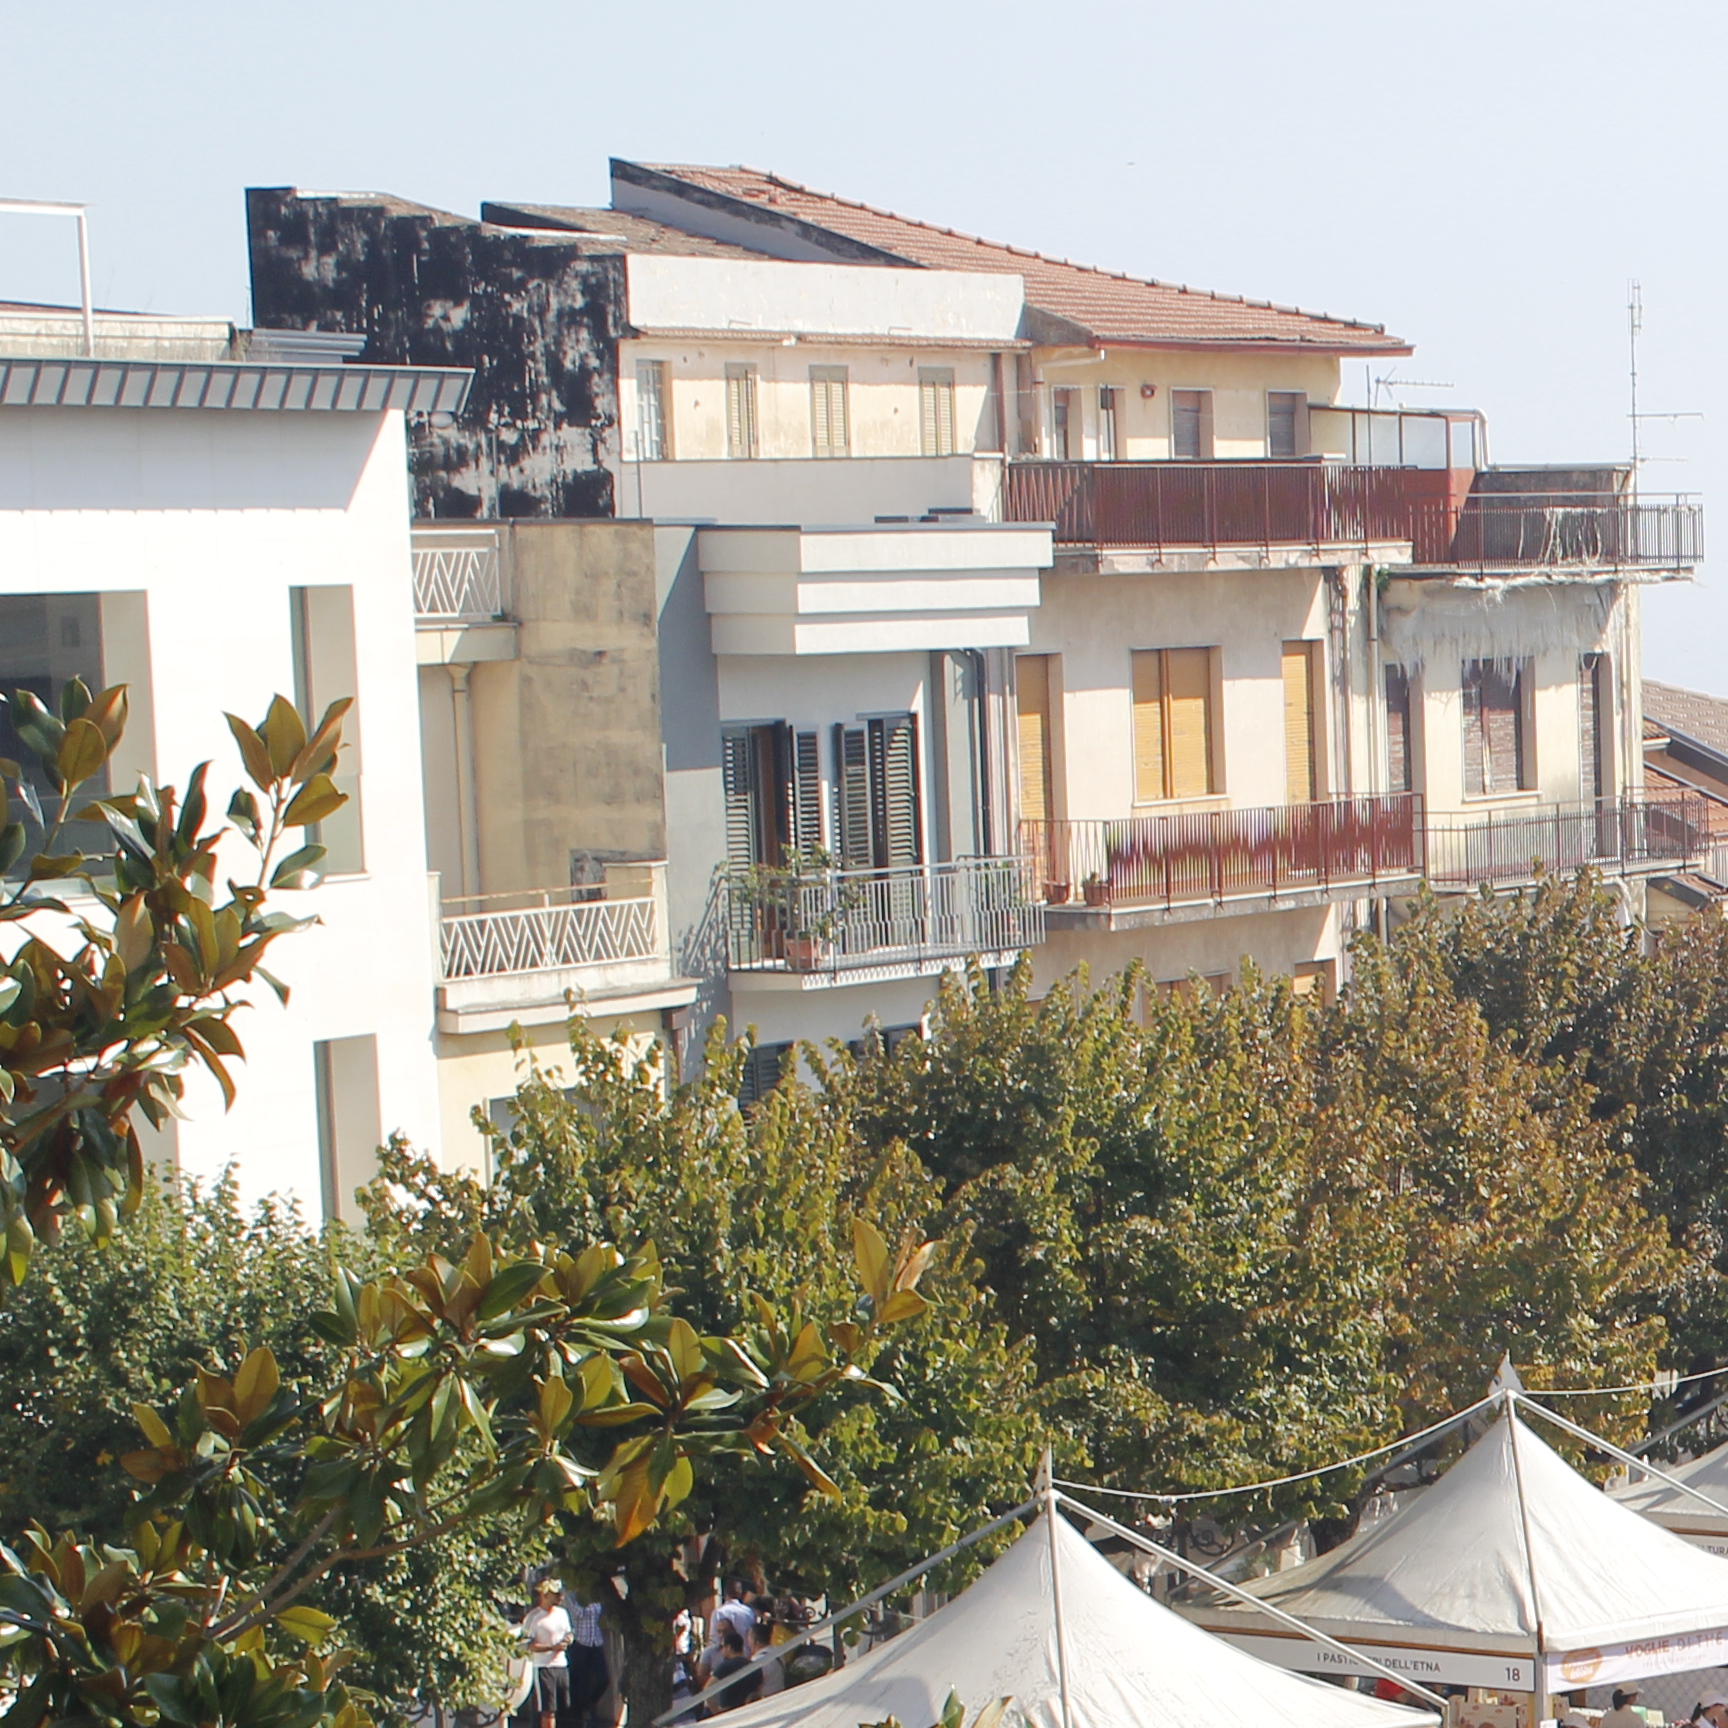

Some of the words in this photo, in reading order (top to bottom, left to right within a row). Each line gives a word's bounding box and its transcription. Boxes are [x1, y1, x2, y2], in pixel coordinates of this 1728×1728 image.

[1625, 1641, 1670, 1660] VOGLIE
[1677, 1637, 1691, 1652] DI
[1384, 1658, 1441, 1672] DELL'ETNA
[1504, 1667, 1520, 1681] 18
